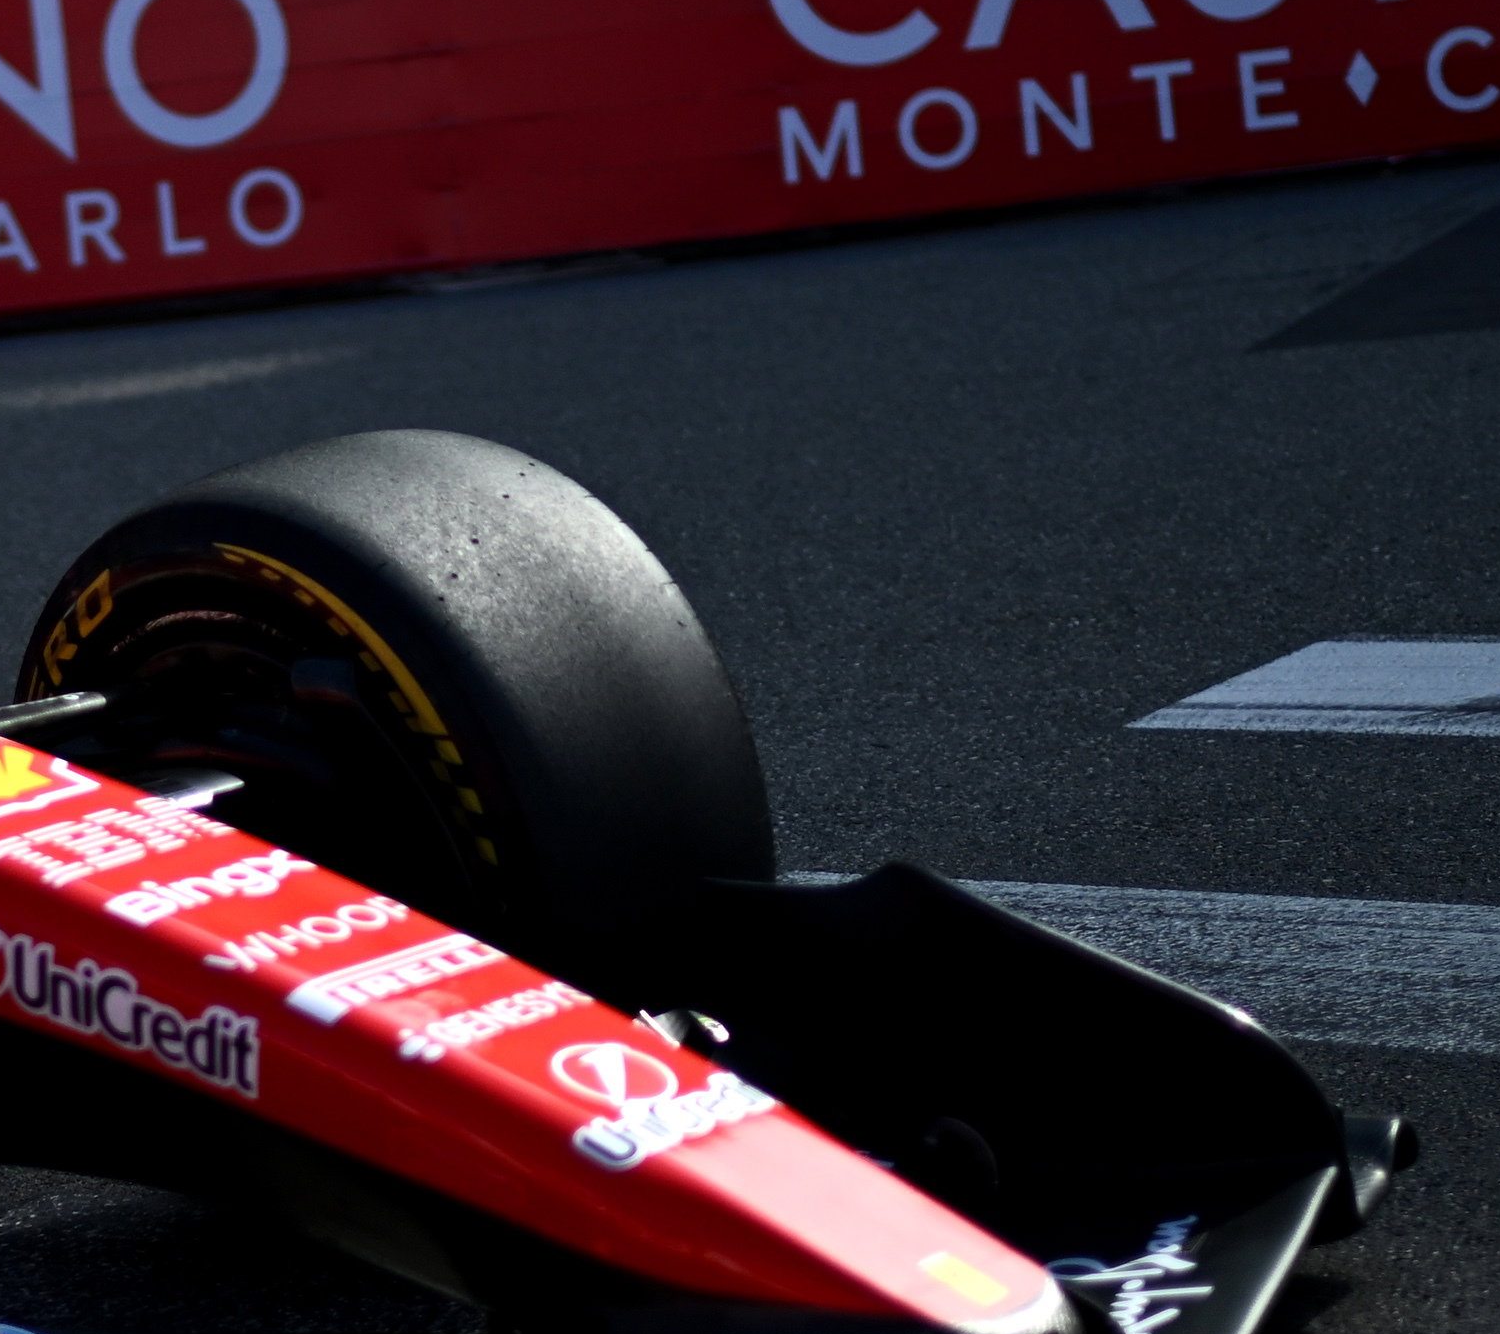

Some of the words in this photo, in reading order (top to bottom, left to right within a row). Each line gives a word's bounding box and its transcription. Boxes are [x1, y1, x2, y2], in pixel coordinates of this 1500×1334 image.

[777, 48, 1300, 184] MONTE
[105, 849, 317, 926] BingX
[204, 896, 409, 972] WHOOP
[10, 935, 258, 1097] UniCredit
